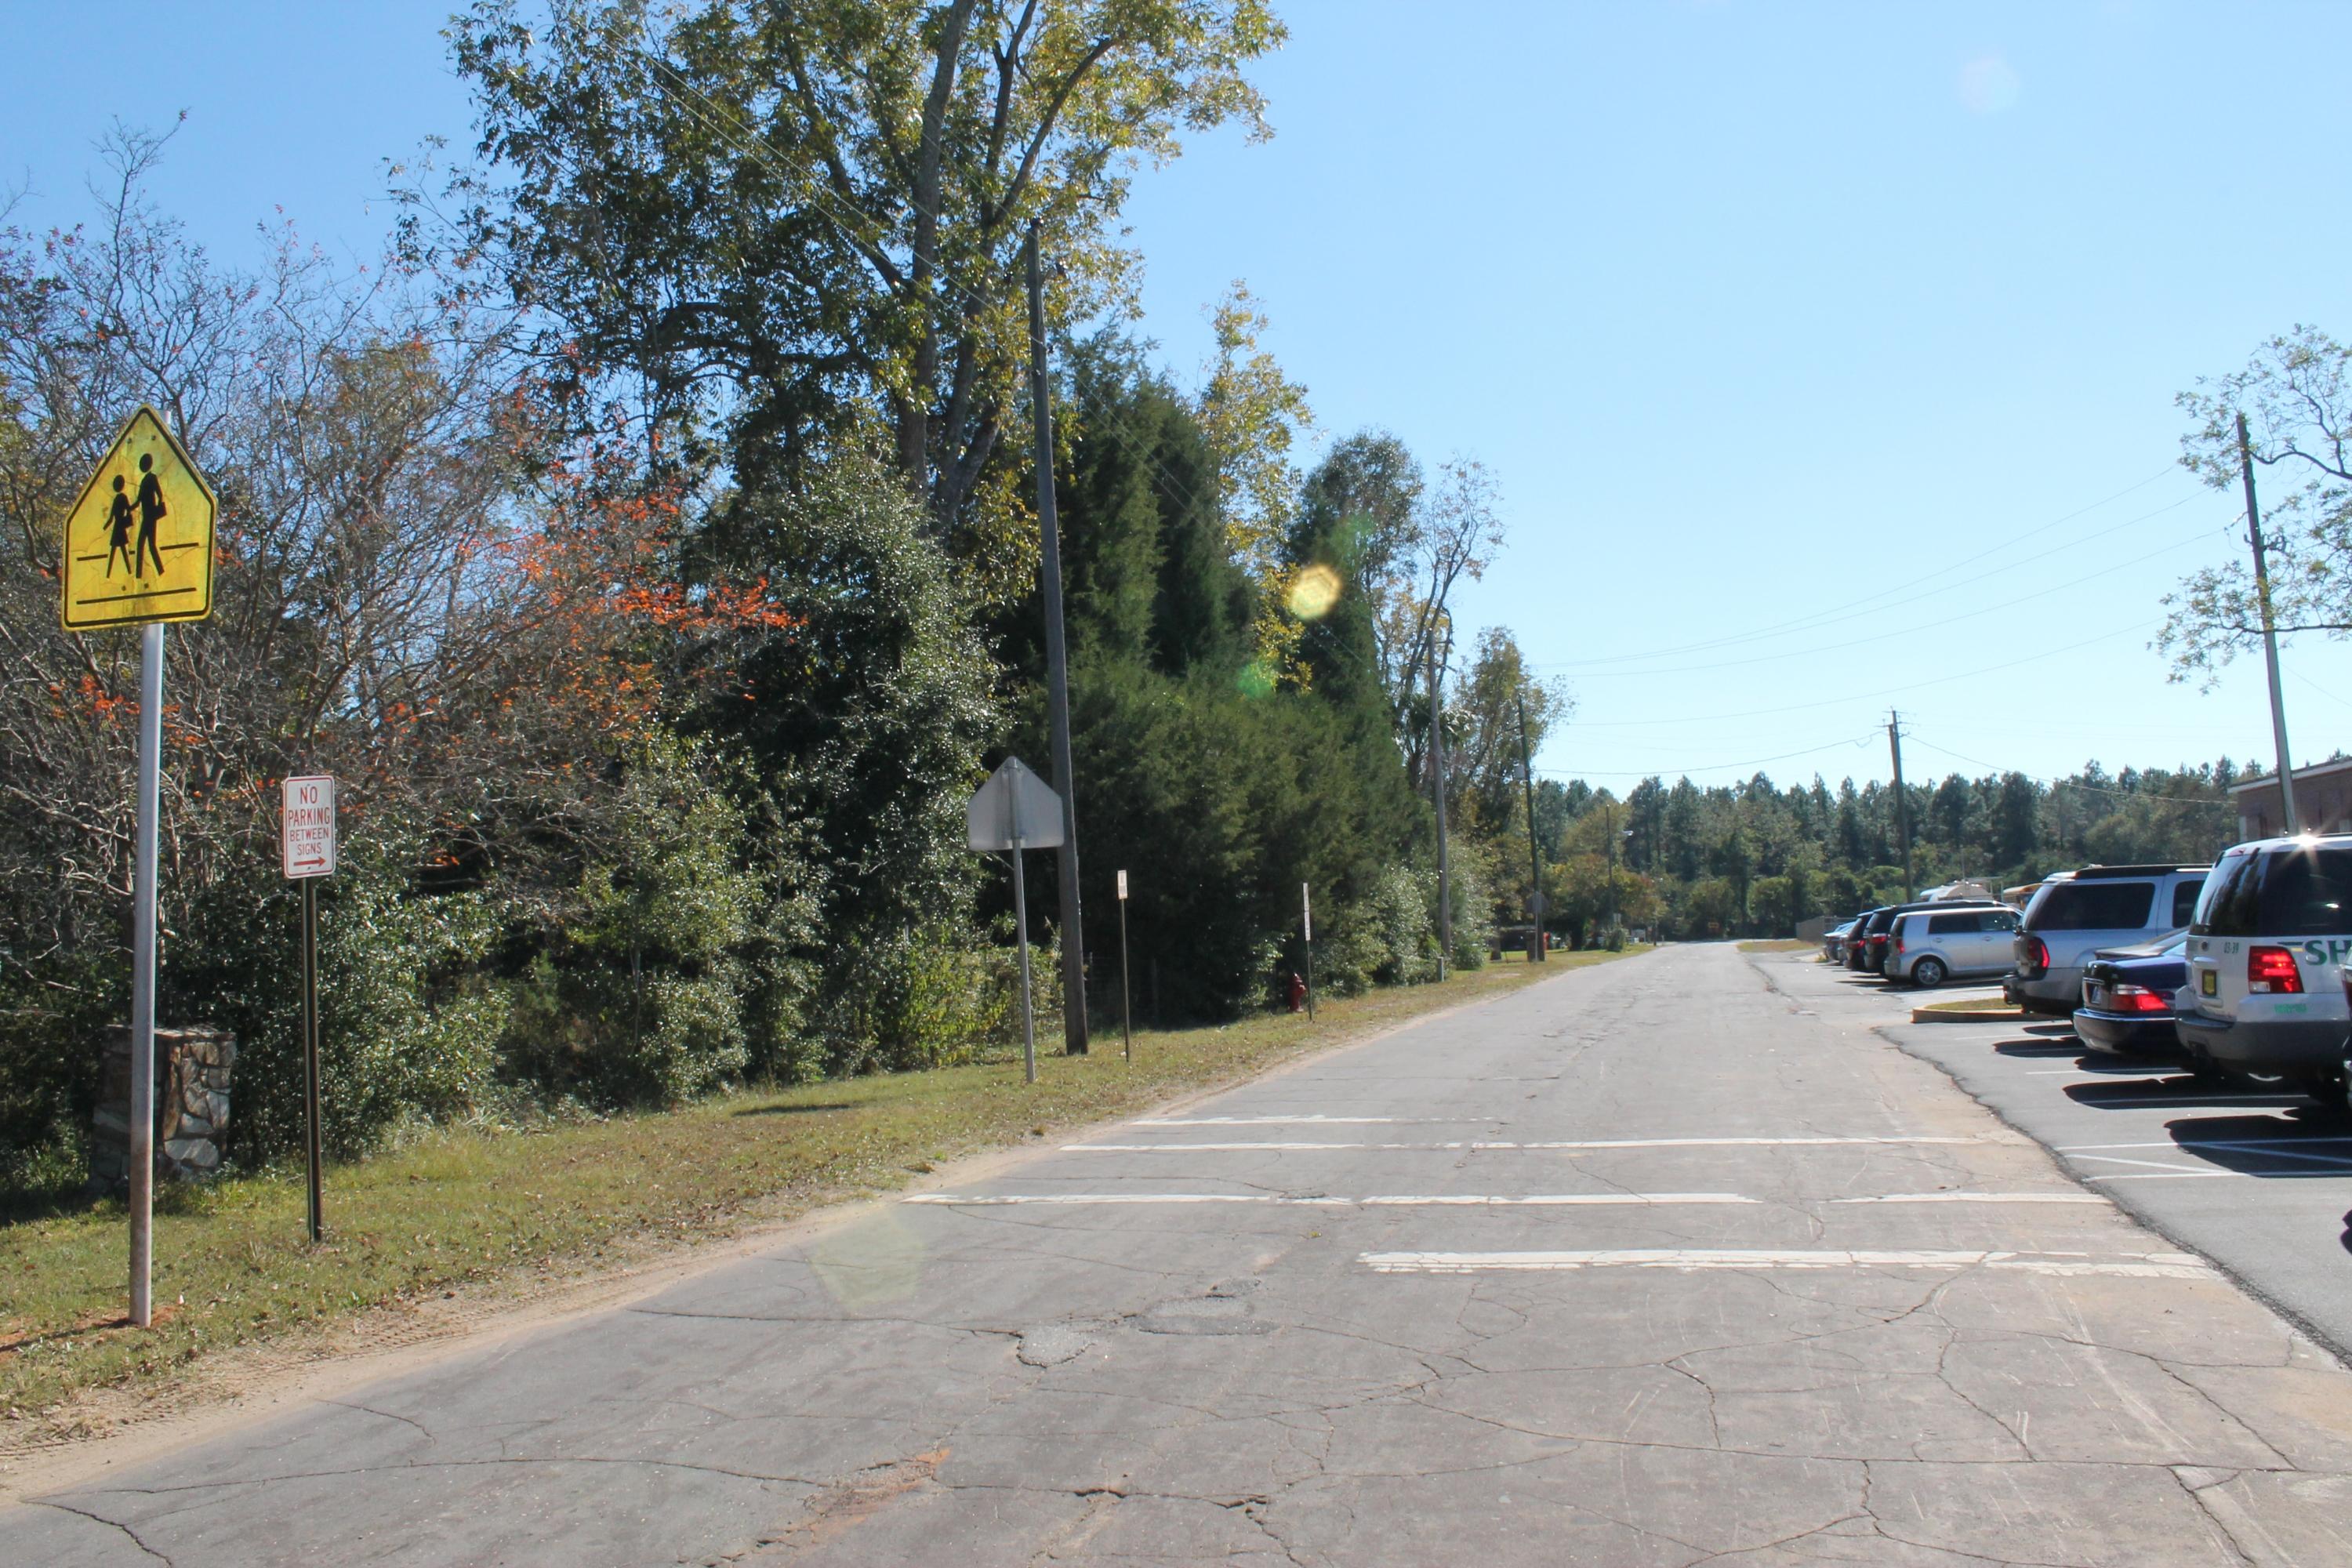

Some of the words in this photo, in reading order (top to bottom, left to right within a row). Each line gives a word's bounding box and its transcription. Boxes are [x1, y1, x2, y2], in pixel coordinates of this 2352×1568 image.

[300, 786, 318, 804] NO
[288, 807, 331, 827] PARKING
[289, 827, 329, 842] BETWEEN
[297, 842, 322, 856] SIGNS
